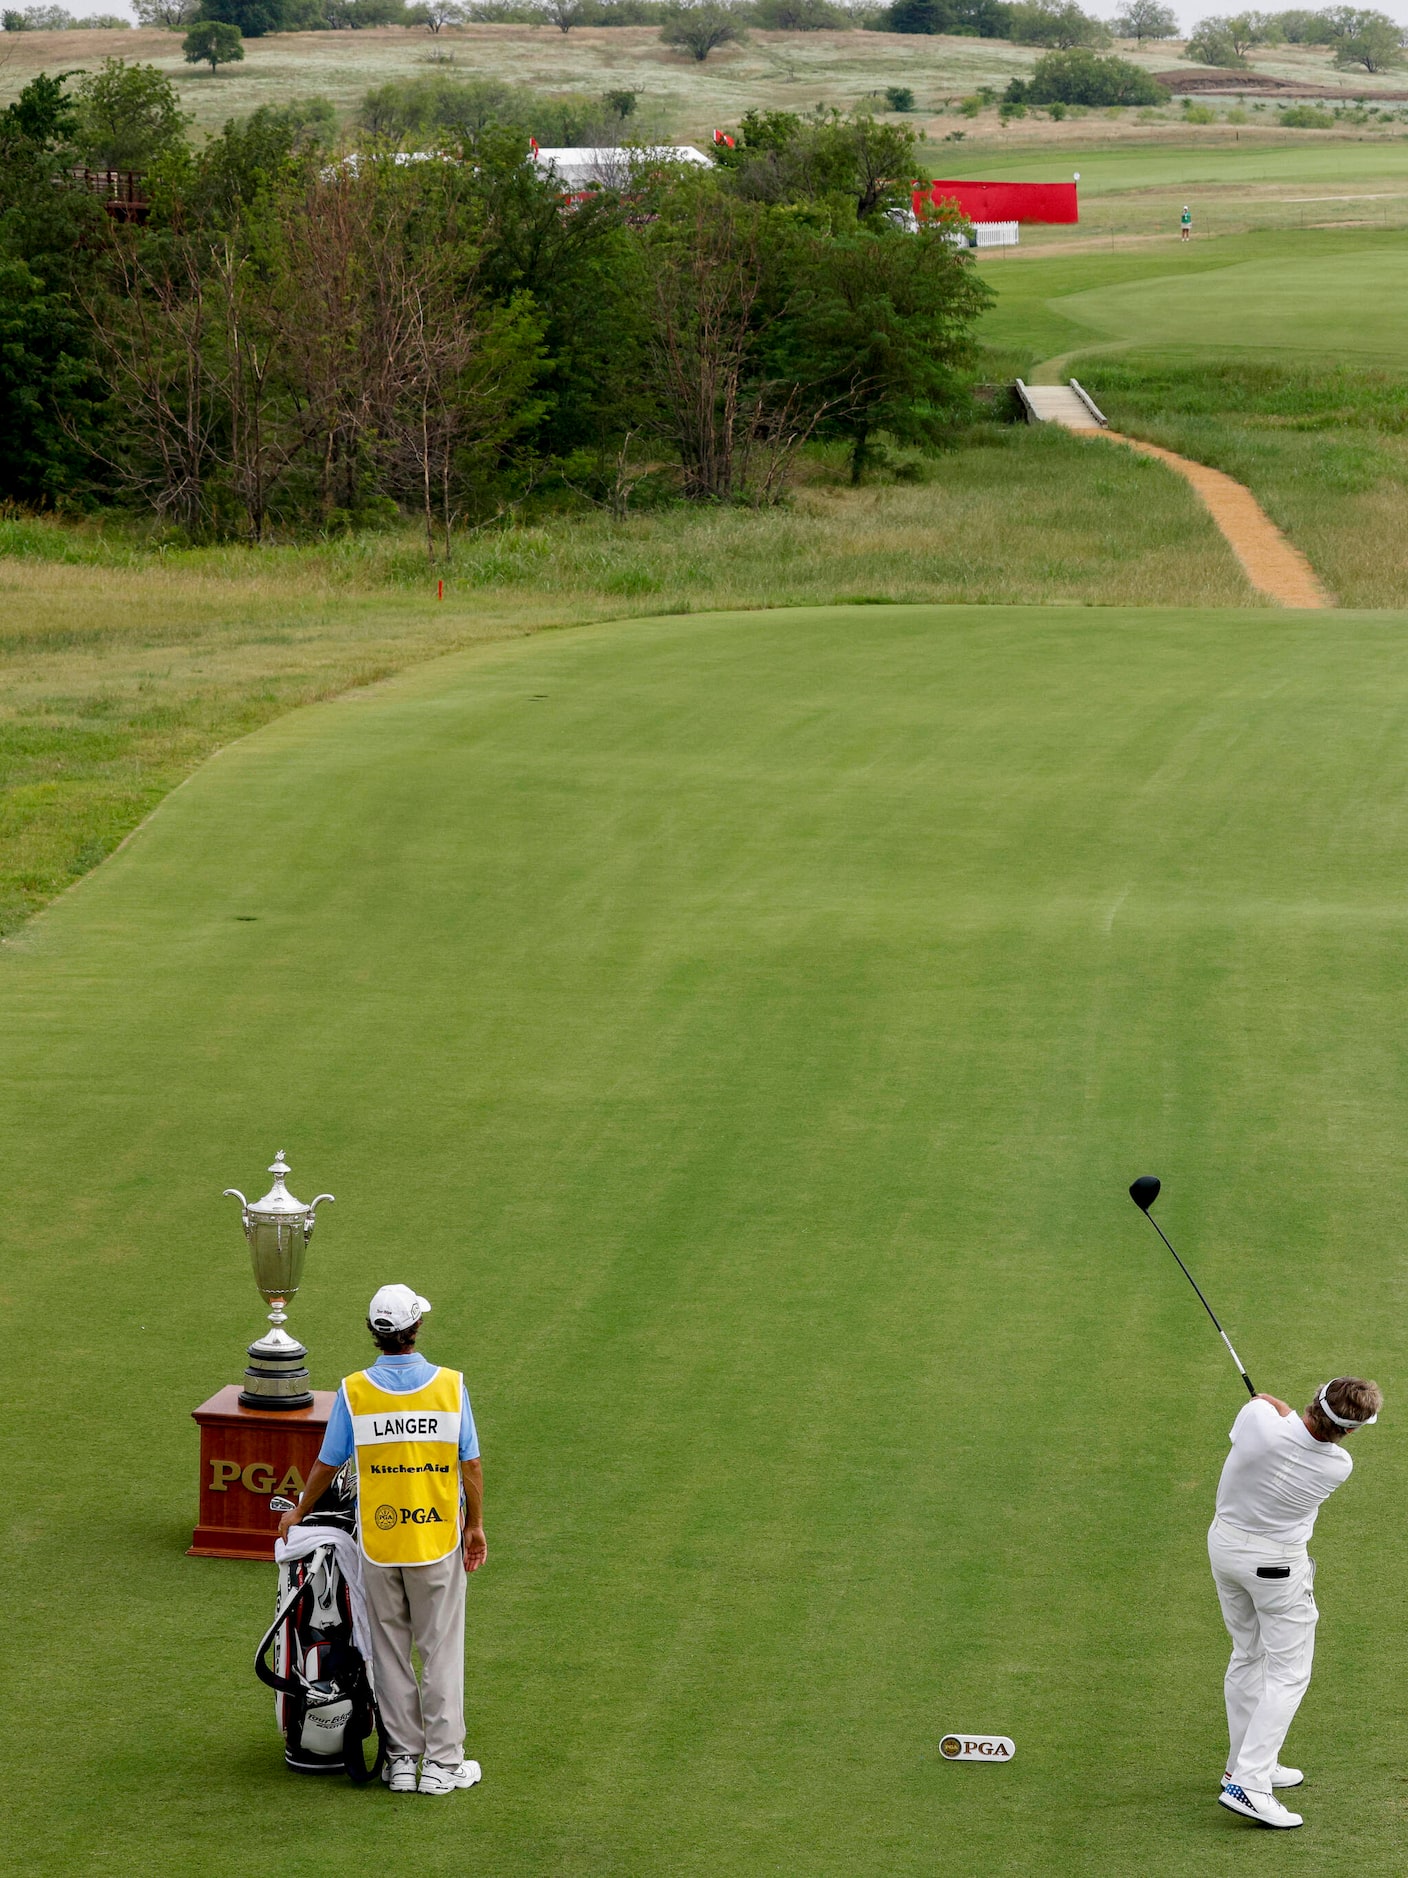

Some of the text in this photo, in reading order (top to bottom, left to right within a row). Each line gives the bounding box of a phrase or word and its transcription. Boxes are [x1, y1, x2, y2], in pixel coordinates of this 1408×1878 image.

[373, 1418, 438, 1437] LANGER
[371, 1463, 450, 1474] KitchenAid
[208, 1459, 306, 1497] PGA
[400, 1507, 443, 1524] PGA
[307, 1712, 331, 1724] Tour
[963, 1741, 1010, 1756] PGA
